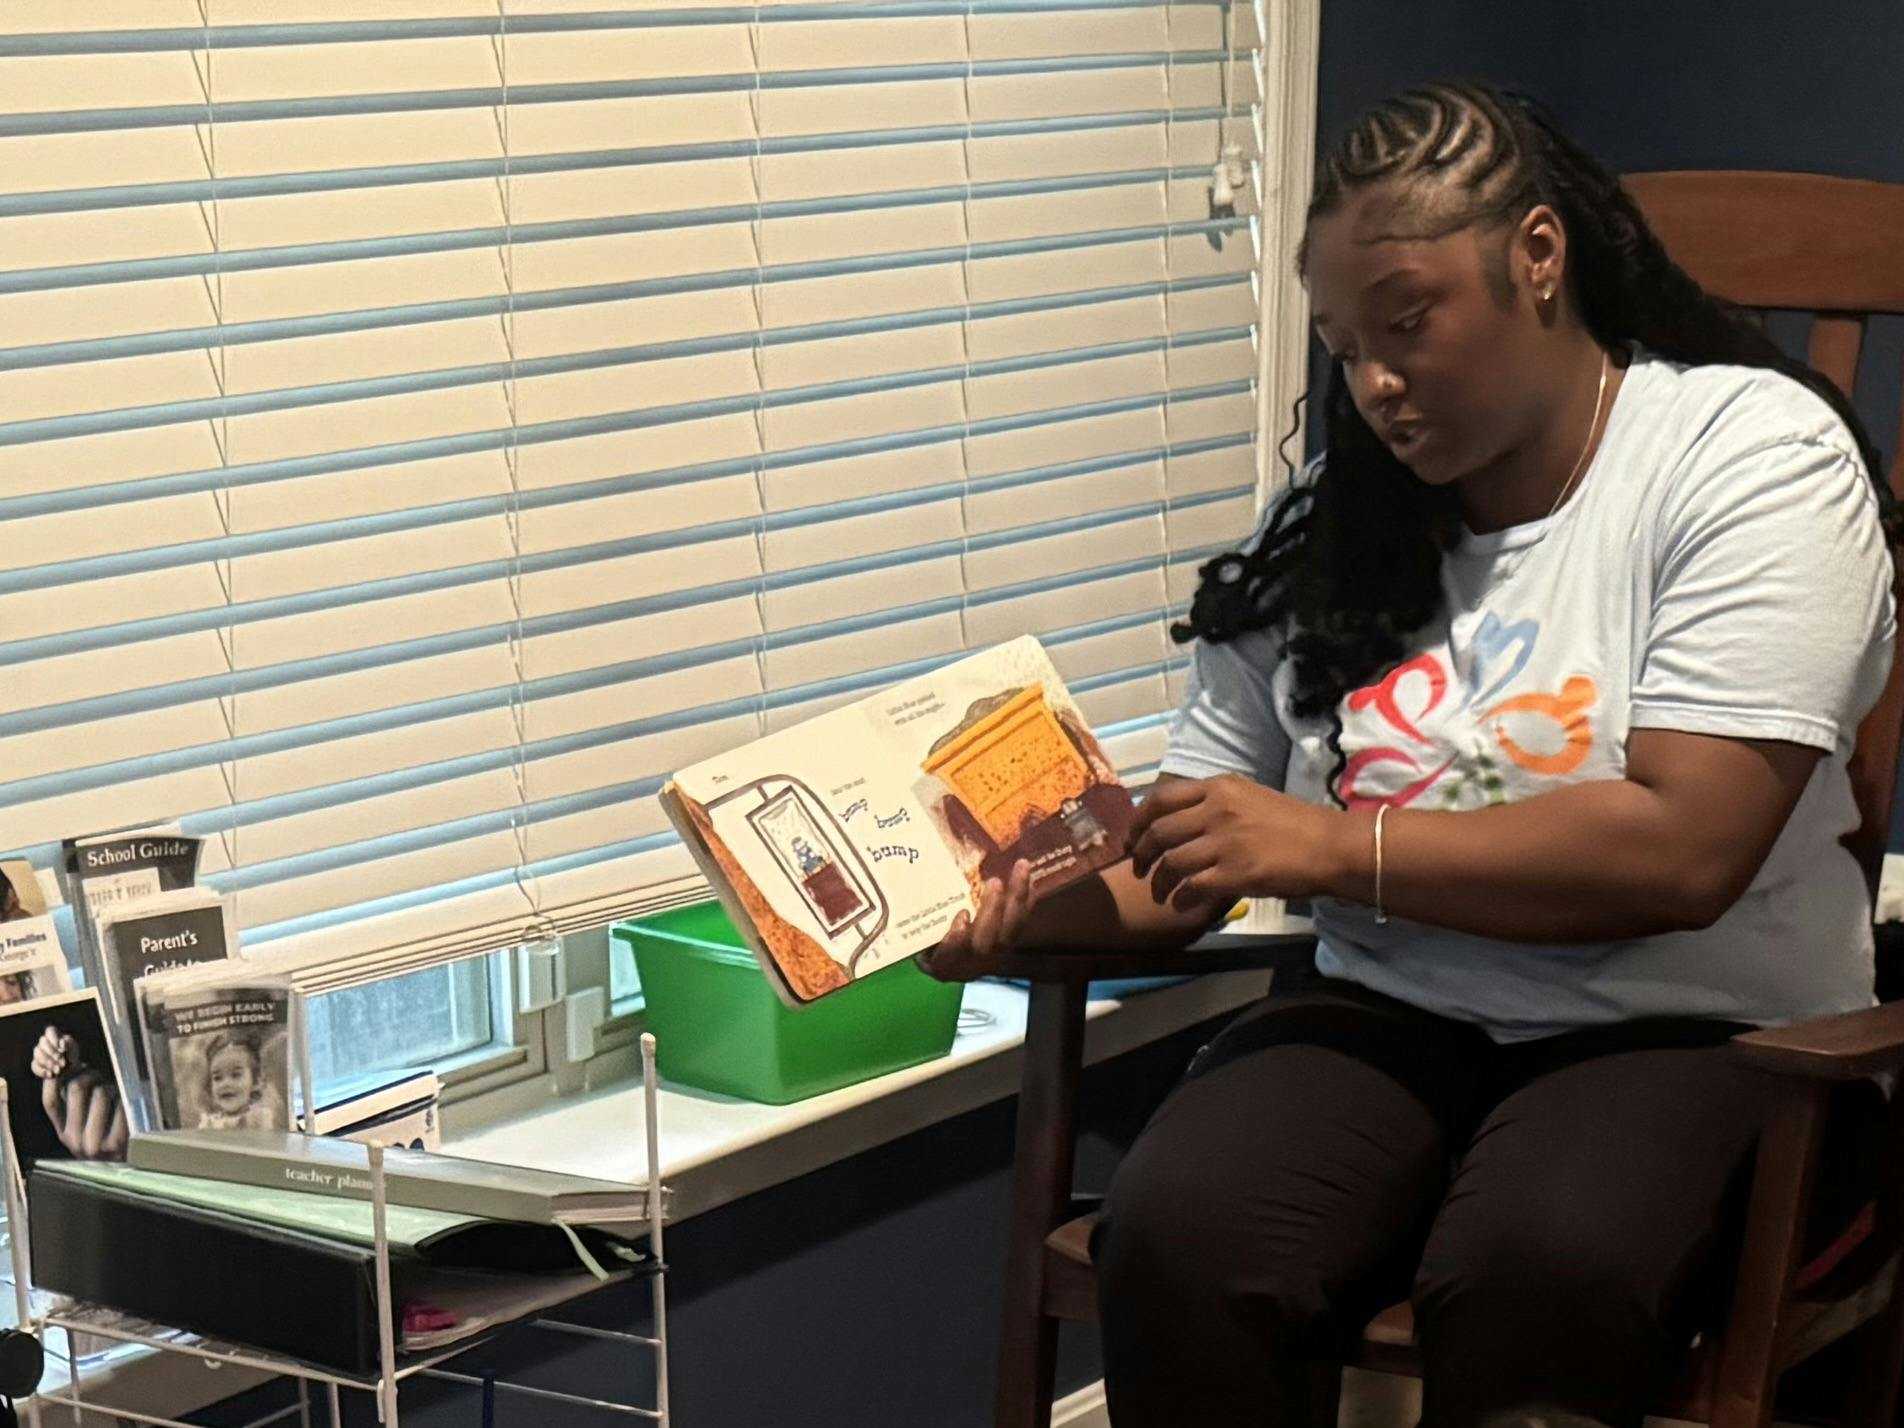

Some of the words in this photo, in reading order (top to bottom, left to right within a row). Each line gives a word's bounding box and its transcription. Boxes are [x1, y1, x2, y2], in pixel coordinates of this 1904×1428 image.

[87, 843, 136, 867] School
[139, 840, 189, 859] Guide
[867, 845, 920, 864] bump
[140, 930, 198, 953] Parent's
[235, 1002, 274, 1012] EARLY
[286, 1167, 334, 1185] teacher
